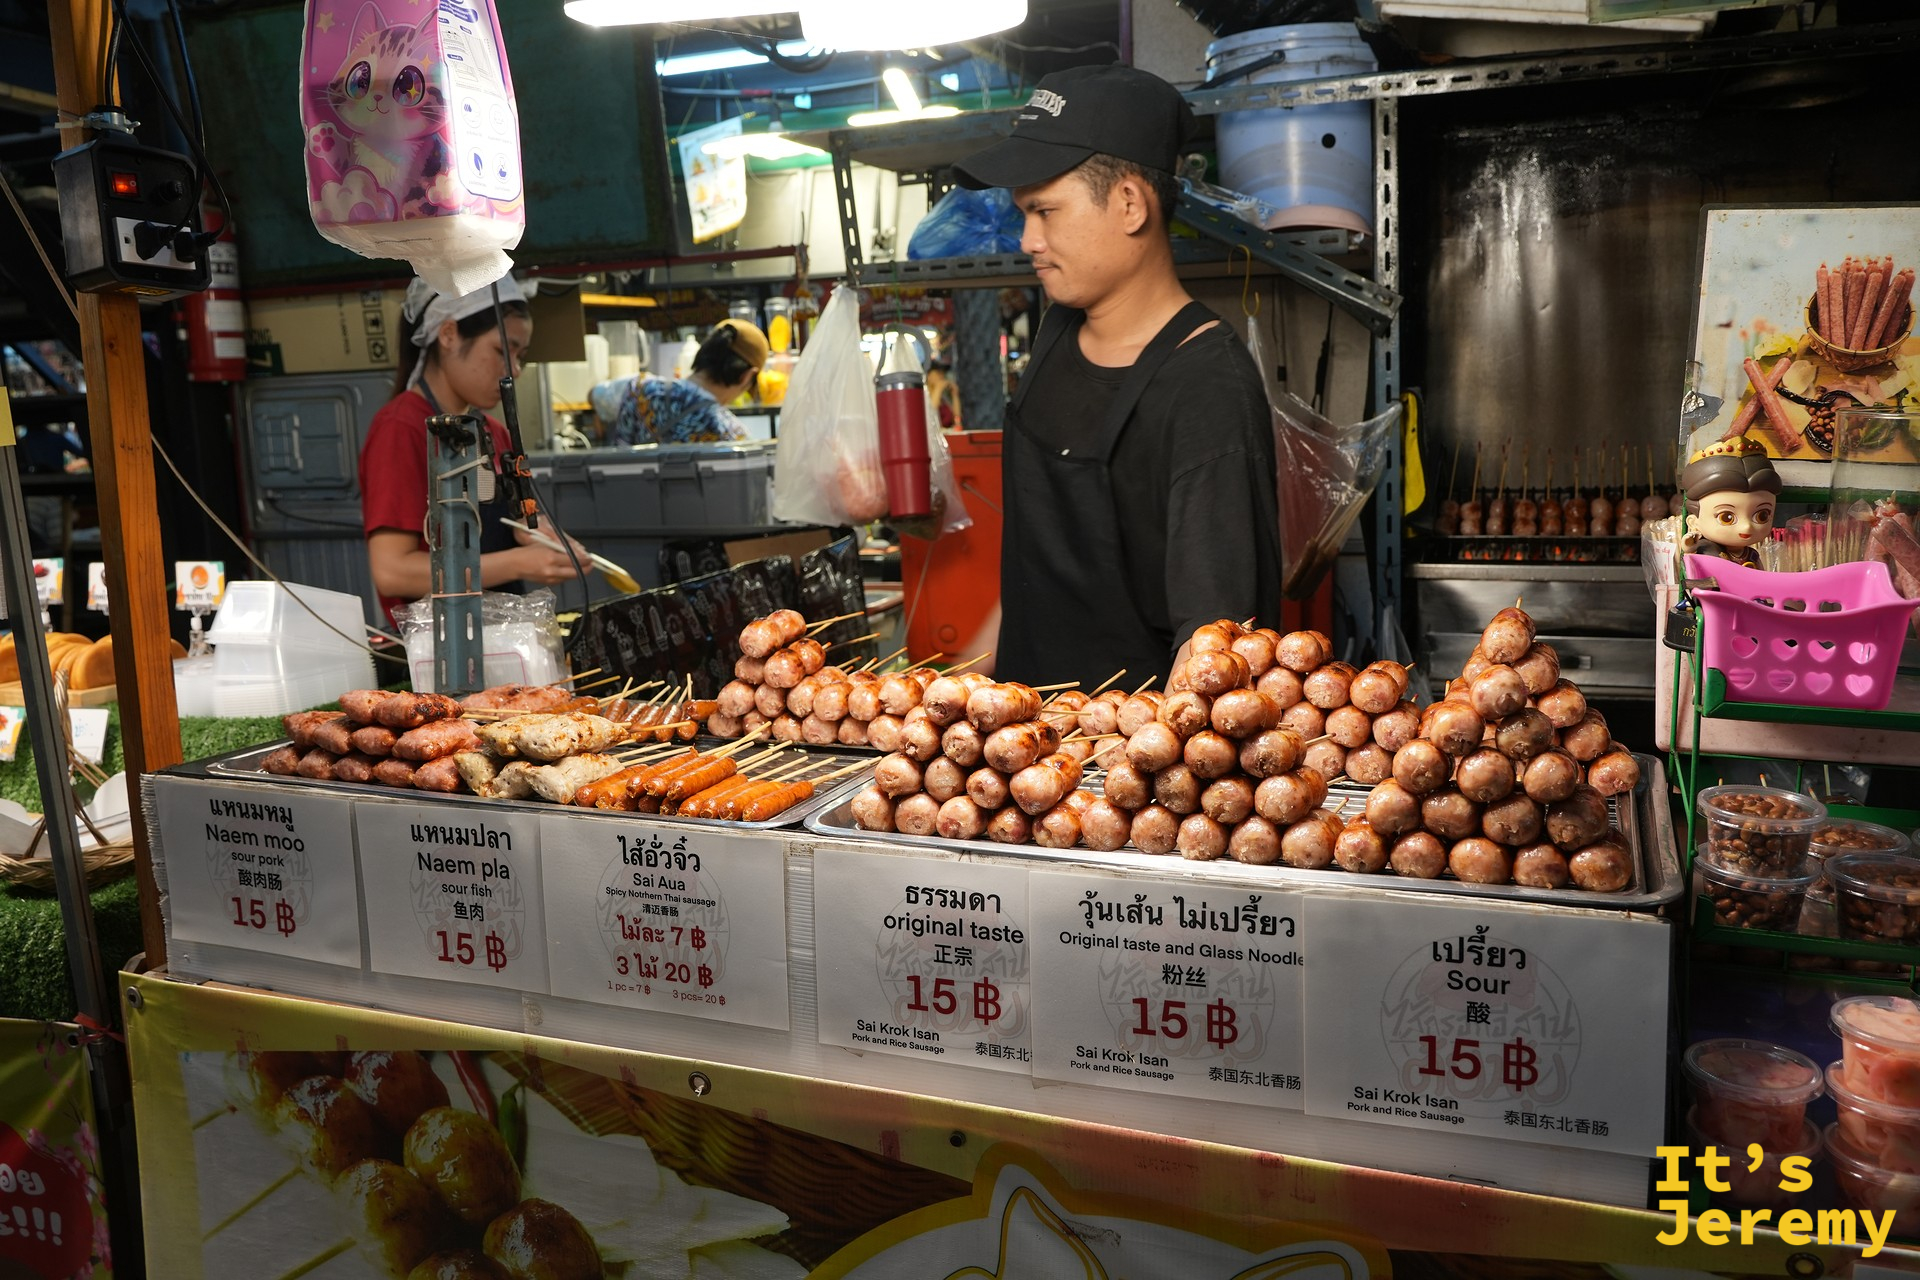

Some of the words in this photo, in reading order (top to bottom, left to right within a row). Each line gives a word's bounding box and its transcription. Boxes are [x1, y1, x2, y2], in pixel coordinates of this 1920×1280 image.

[209, 799, 294, 832] แหนมหมู
[206, 823, 258, 846] Naem
[264, 834, 305, 852] moo
[411, 823, 512, 850] แหนมปลา
[231, 852, 255, 863] sour
[259, 855, 284, 867] pork
[617, 834, 701, 872] ไส้อั่วจิ๋ว
[418, 852, 475, 875] Naem
[482, 858, 510, 881] pla
[238, 869, 282, 891] 酸肉肠
[442, 884, 467, 895] sour
[471, 884, 492, 897] fish
[633, 873, 654, 887] Sai
[658, 876, 686, 891] Aua
[605, 887, 626, 897] Spicy
[664, 894, 681, 903] Thai
[683, 896, 716, 907] sausage
[905, 885, 1001, 914] ธรรมดา
[232, 897, 266, 929] 15
[453, 901, 484, 921] 鱼肉
[642, 904, 679, 917] 清迈香肠
[1078, 890, 1163, 929] วุ้นเส้น
[1173, 895, 1295, 938] ไม่เปรี้ยว
[617, 914, 664, 943] ไม้ละ
[671, 926, 683, 946] 7
[884, 912, 963, 937] original
[970, 921, 1024, 944] taste
[436, 931, 475, 965] 15
[934, 944, 972, 966] 正宗
[1059, 931, 1119, 949] Original
[1123, 938, 1161, 953] taste
[1165, 941, 1194, 956] and
[1199, 944, 1243, 961] Glass
[1432, 925, 1527, 970] เปรี้ยว
[616, 956, 629, 975] 3
[634, 953, 659, 979] ไม้
[665, 962, 690, 984] 20
[1162, 963, 1207, 987] 粉丝
[615, 983, 626, 992] pc
[636, 984, 642, 993] 7
[907, 975, 957, 1015] 15
[1447, 970, 1510, 995] Sour
[672, 990, 679, 998] 3
[705, 994, 716, 1004] 20
[1132, 997, 1188, 1039] 15
[1466, 1001, 1491, 1025] 酸
[857, 1019, 876, 1032] Sai
[880, 1022, 910, 1038] Krok
[913, 1027, 940, 1041] Isan
[852, 1033, 870, 1043] Pork
[872, 1035, 887, 1045] and
[889, 1038, 907, 1048] Rice
[909, 1041, 945, 1054] Sausage
[975, 1041, 1032, 1062] 泰国东北
[1076, 1045, 1098, 1059] Sai
[1102, 1047, 1135, 1063] Krok
[1139, 1052, 1169, 1067] Isan
[1418, 1035, 1481, 1080] 15
[1070, 1060, 1091, 1071] Pork
[1093, 1063, 1110, 1073] and
[1112, 1065, 1132, 1075] Rice
[1134, 1068, 1174, 1082] Sausage
[1208, 1066, 1301, 1091] 泰国东北香肠
[1354, 1086, 1378, 1101] Sai
[1383, 1089, 1421, 1106] Krok
[1425, 1093, 1459, 1110] Isan
[1347, 1102, 1370, 1113] Pork
[1373, 1105, 1392, 1115] and
[1395, 1107, 1417, 1118] Rice
[1420, 1110, 1465, 1124] Sausage
[1504, 1110, 1609, 1137] 泰国东北香肠
